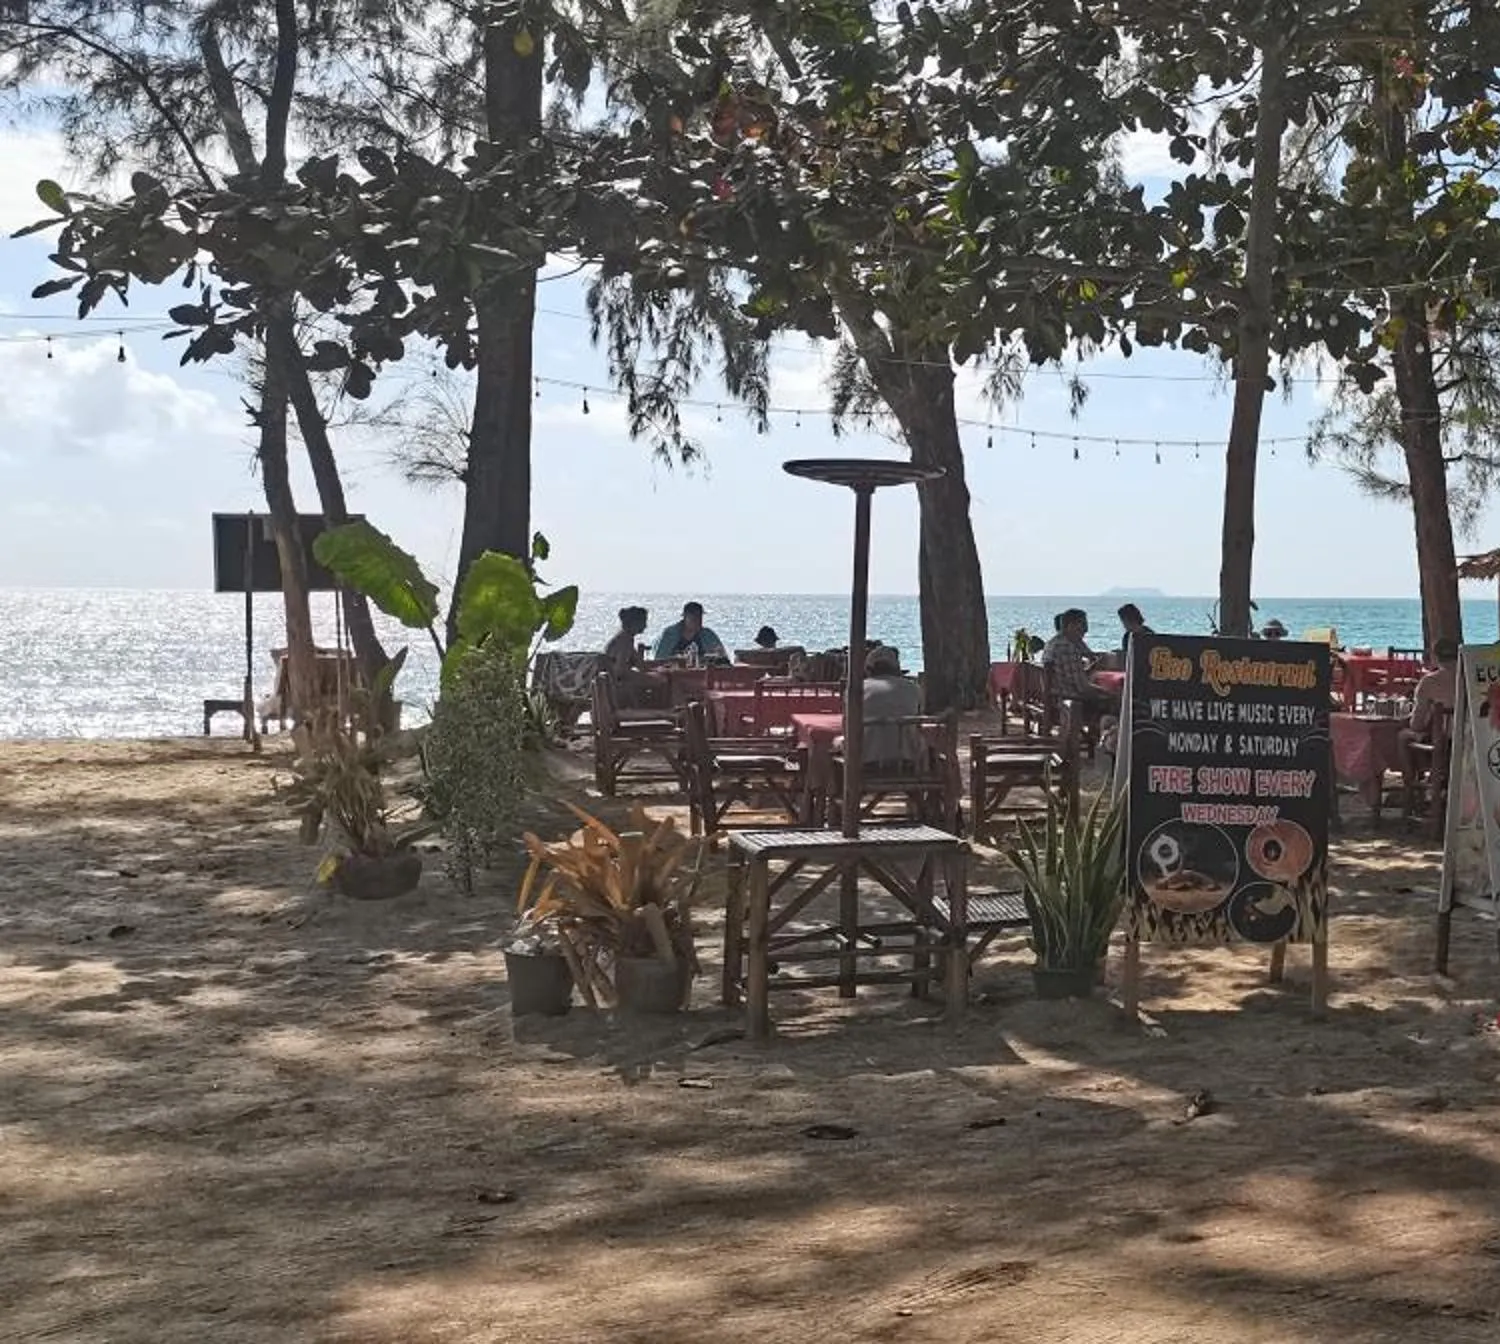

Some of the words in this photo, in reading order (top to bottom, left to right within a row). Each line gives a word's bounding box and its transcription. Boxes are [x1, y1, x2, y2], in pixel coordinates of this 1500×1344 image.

[1200, 649, 1317, 696] Restaurant
[1151, 700, 1167, 719] WE
[1172, 701, 1203, 720] HAVE
[1208, 702, 1235, 721] LIVE
[1239, 703, 1275, 724] MUSIC
[1279, 705, 1315, 725] EVERY
[1168, 732, 1219, 752] MONDAY
[1224, 735, 1233, 754] &
[1239, 735, 1299, 756] SATURDAY
[1148, 765, 1193, 794] FIRE
[1197, 766, 1252, 796] SHOW
[1255, 769, 1317, 799] EVERY
[1181, 802, 1281, 826] WEDNESDAY
